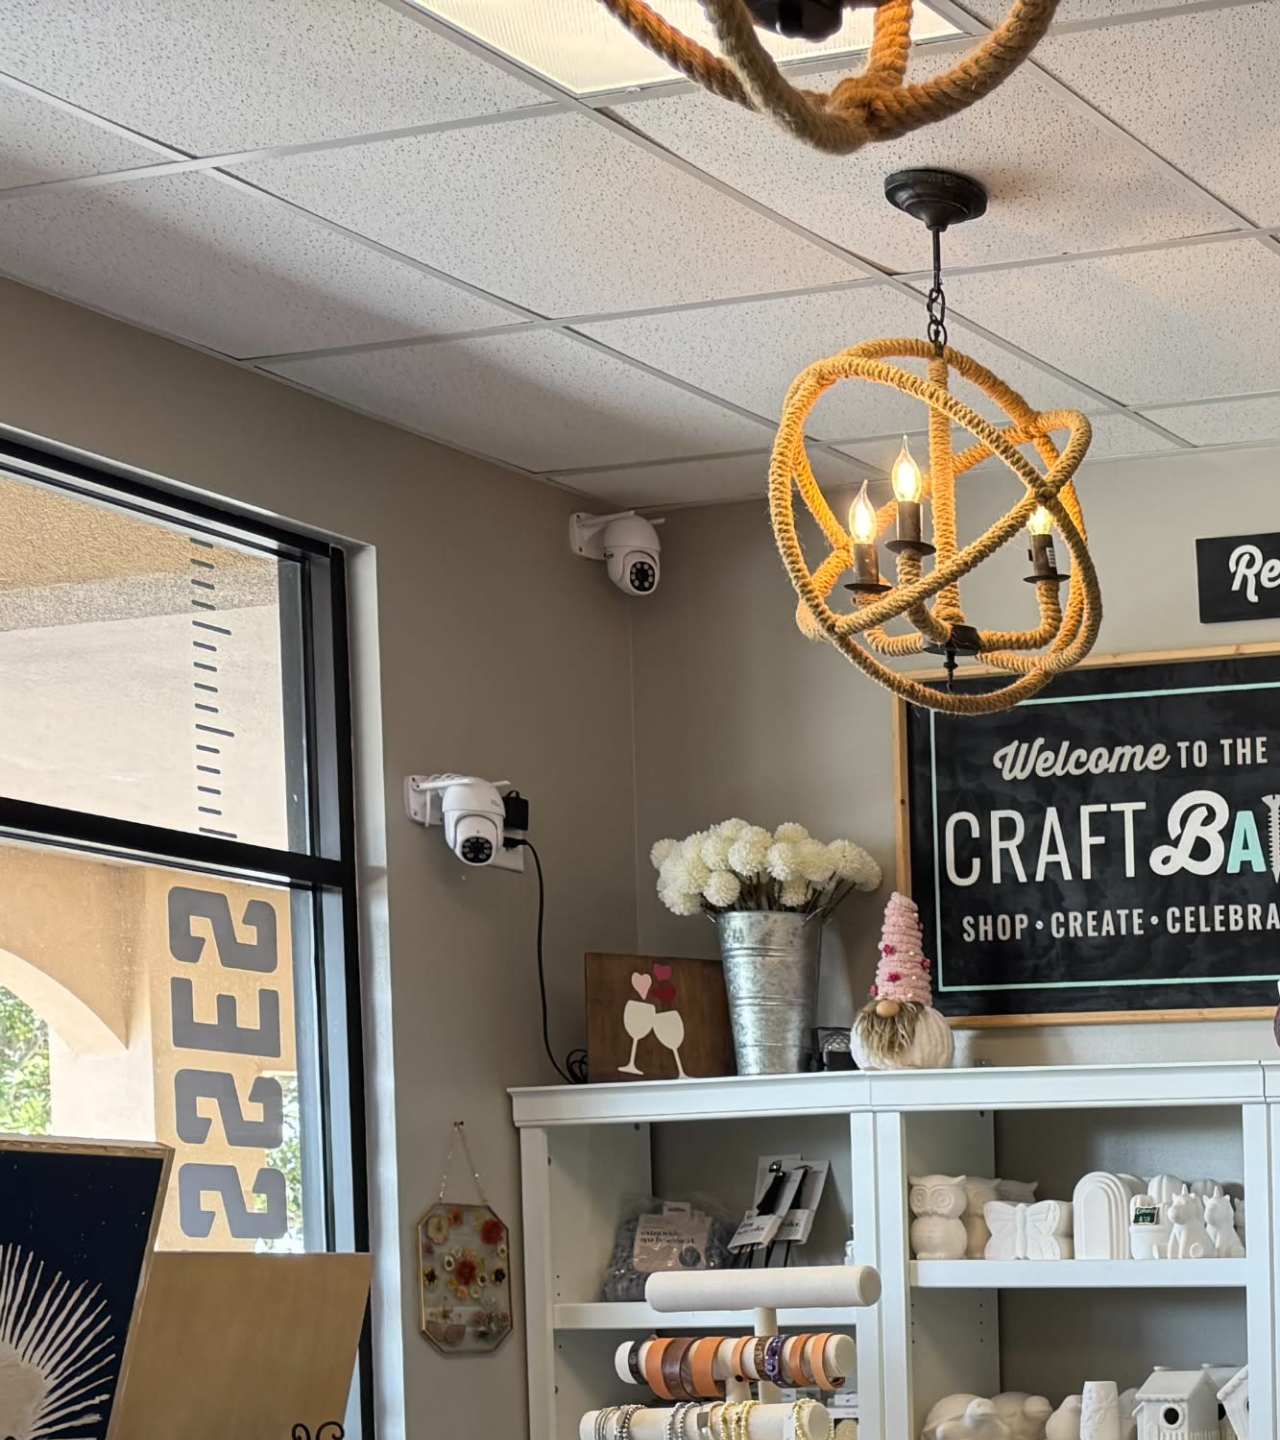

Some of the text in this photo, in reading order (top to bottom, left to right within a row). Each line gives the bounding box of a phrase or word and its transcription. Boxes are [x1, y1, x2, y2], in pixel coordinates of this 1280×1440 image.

[993, 736, 1268, 781] Welcome TO THE
[944, 801, 1147, 887] CRAFT
[962, 912, 1029, 942] SHOP
[1050, 908, 1145, 938] CREATE
